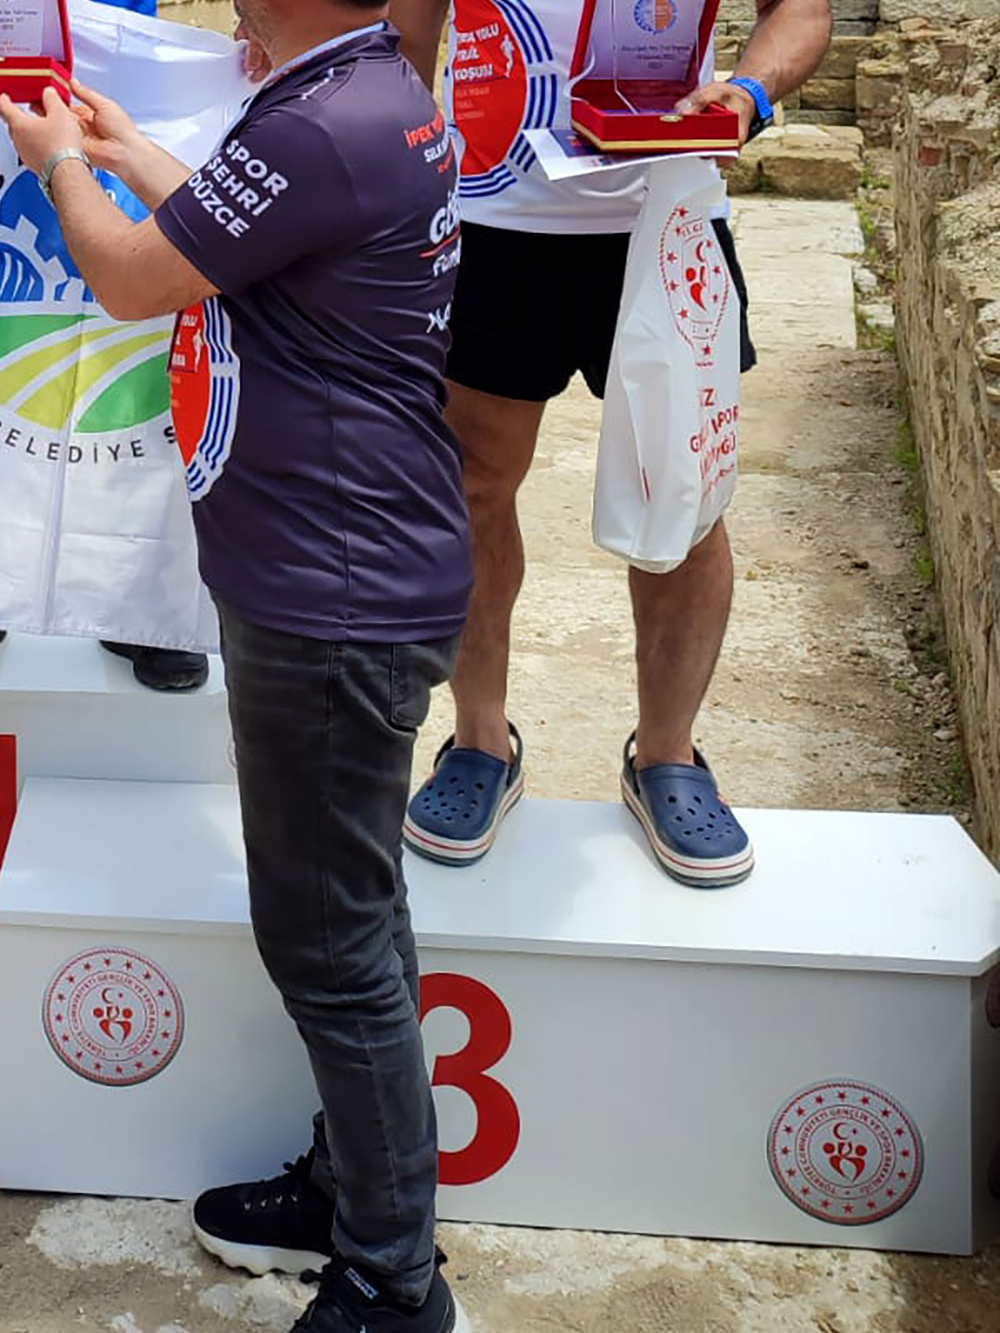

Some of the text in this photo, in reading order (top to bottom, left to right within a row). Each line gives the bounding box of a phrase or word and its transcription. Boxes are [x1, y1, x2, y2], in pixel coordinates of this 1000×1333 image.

[205, 156, 273, 216] ŞEHRİ
[226, 140, 289, 196] SPOR
[188, 172, 250, 237] DÜZCE
[418, 973, 521, 1185] 3
